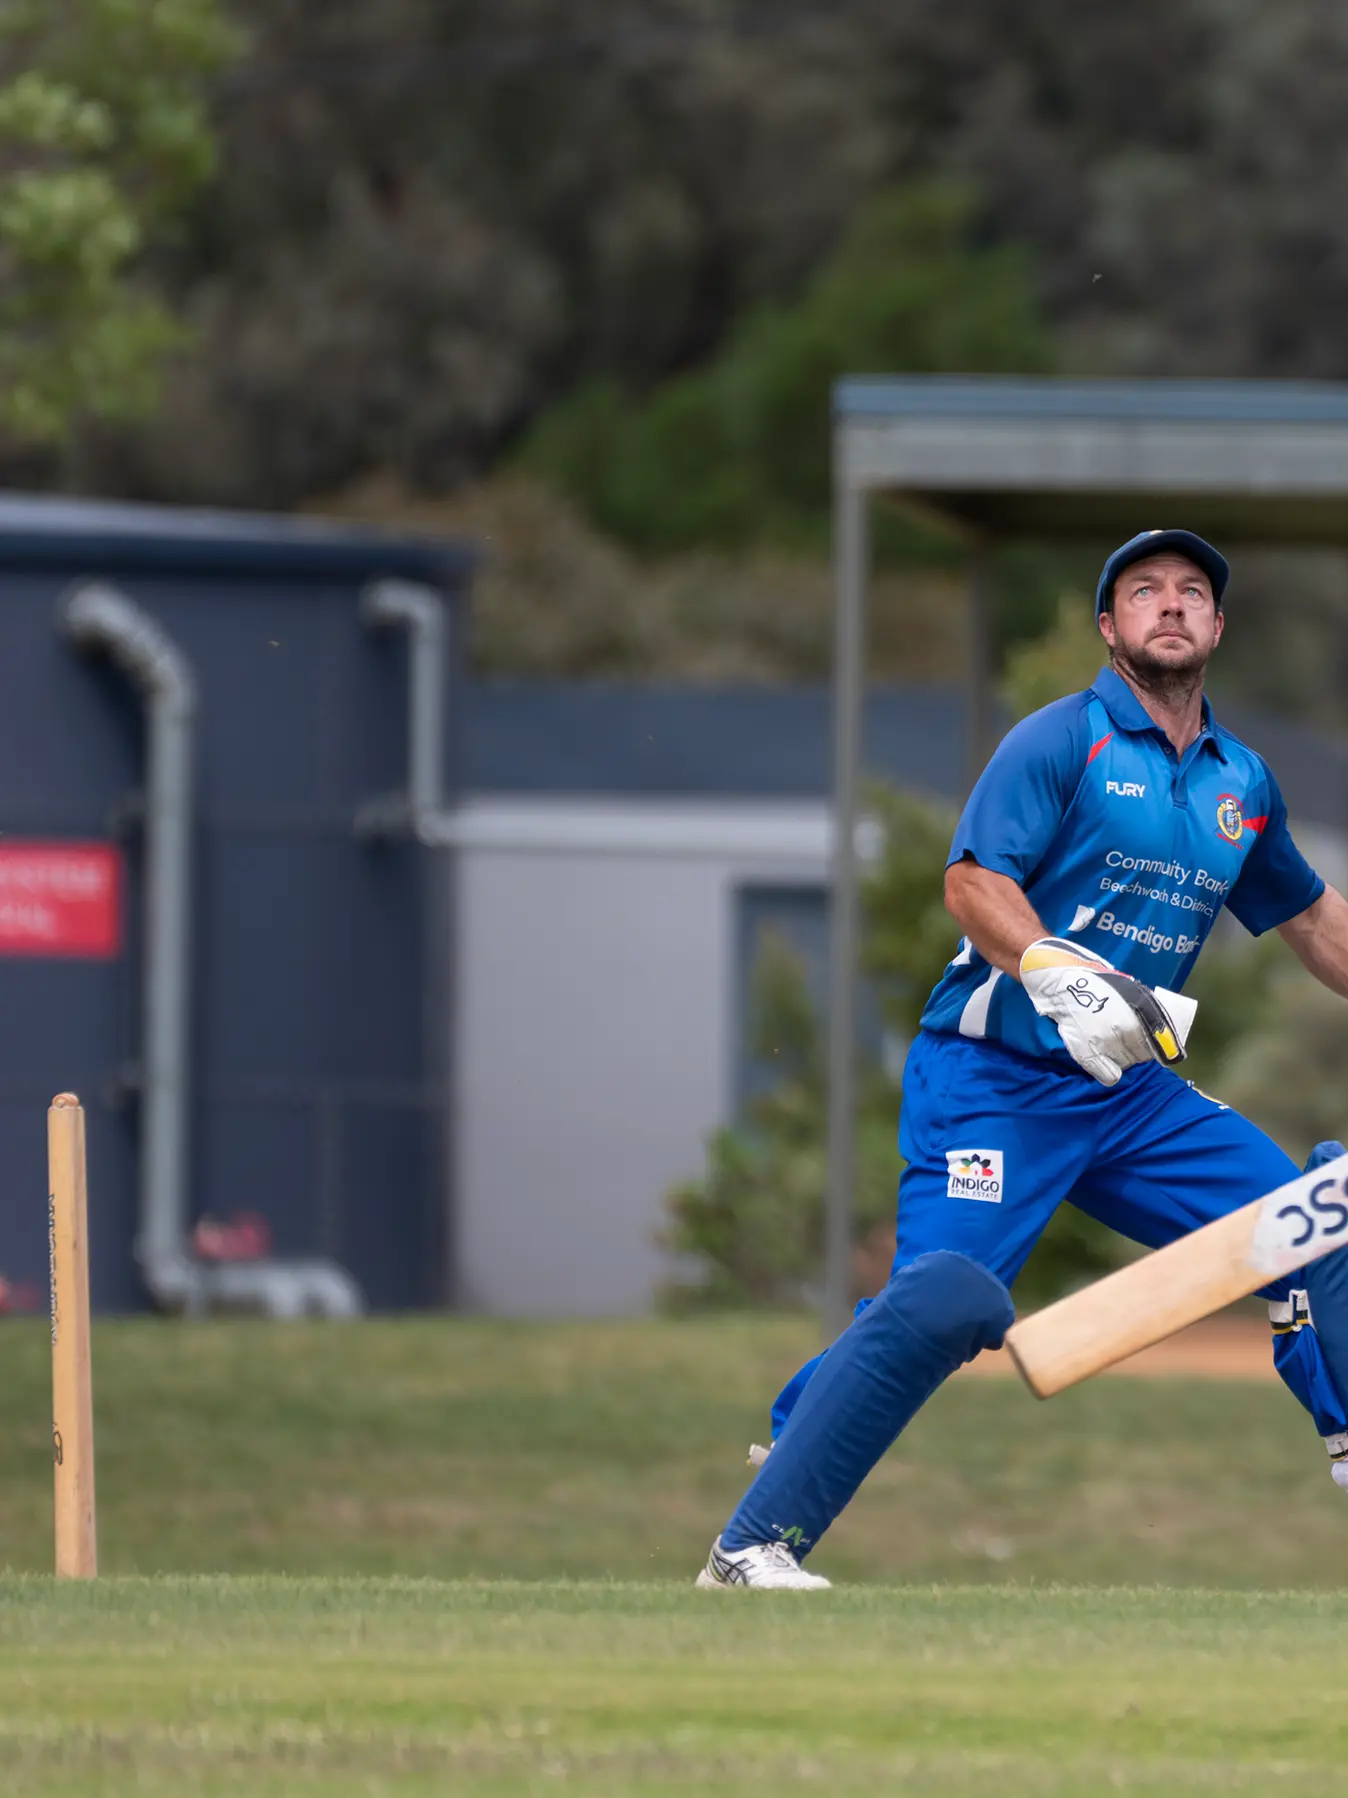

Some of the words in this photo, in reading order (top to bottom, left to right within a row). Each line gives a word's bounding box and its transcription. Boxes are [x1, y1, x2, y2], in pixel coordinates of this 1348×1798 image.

[1106, 780, 1146, 798] FURY
[1105, 850, 1191, 885] Commuity
[1096, 911, 1174, 953] Bendigo
[952, 1177, 999, 1193] INDIGO
[952, 1189, 971, 1197] REAL
[972, 1191, 998, 1200] ESTATE
